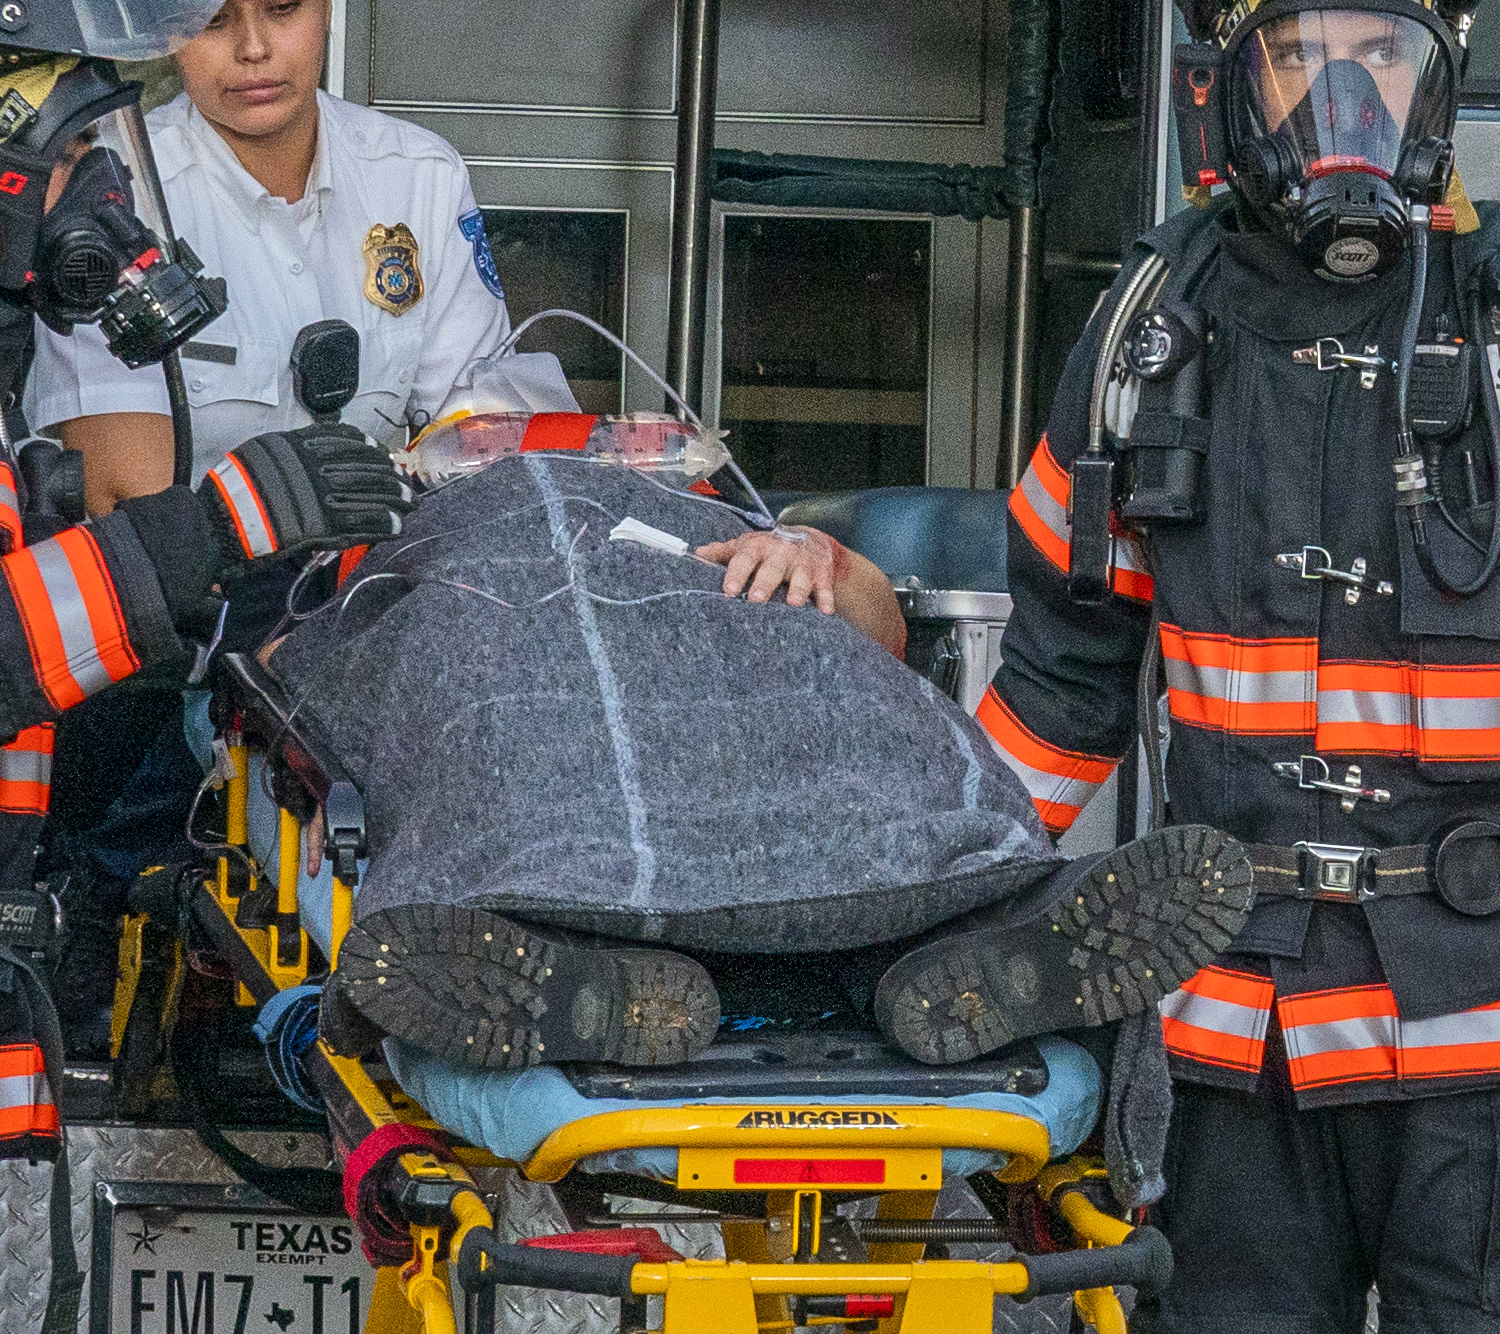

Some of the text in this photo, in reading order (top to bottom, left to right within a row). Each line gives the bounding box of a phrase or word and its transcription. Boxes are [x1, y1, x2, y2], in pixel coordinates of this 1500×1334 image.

[753, 1110, 882, 1129] RUGGED
[230, 1222, 352, 1255] TEXAS
[256, 1253, 326, 1265] EXEMPT
